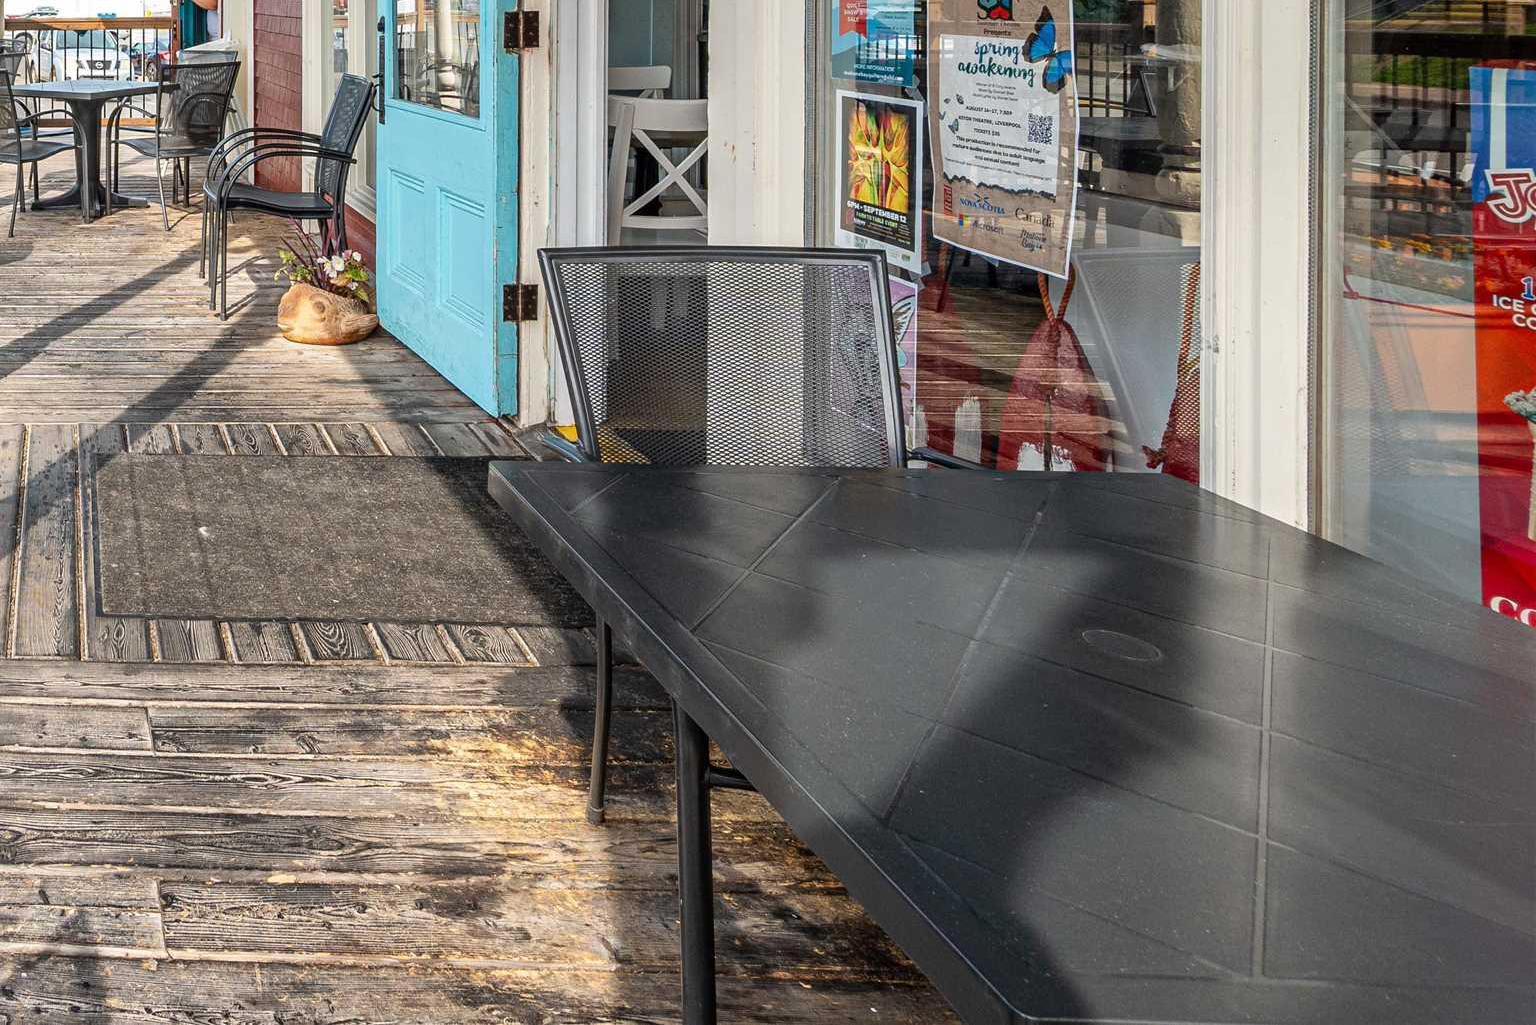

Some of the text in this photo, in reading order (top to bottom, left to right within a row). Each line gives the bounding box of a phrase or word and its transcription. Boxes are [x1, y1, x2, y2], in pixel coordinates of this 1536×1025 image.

[983, 28, 1012, 36] Presents
[974, 41, 1020, 65] spring
[958, 56, 1037, 88] awakening
[965, 105, 983, 113] AUGUST
[994, 120, 1022, 129] LIVERPOOL
[965, 137, 992, 146] production
[959, 197, 977, 209] NOVA
[863, 204, 899, 221] SEPTEMBER
[1015, 206, 1056, 229] Canada
[1492, 293, 1525, 313] ICE
